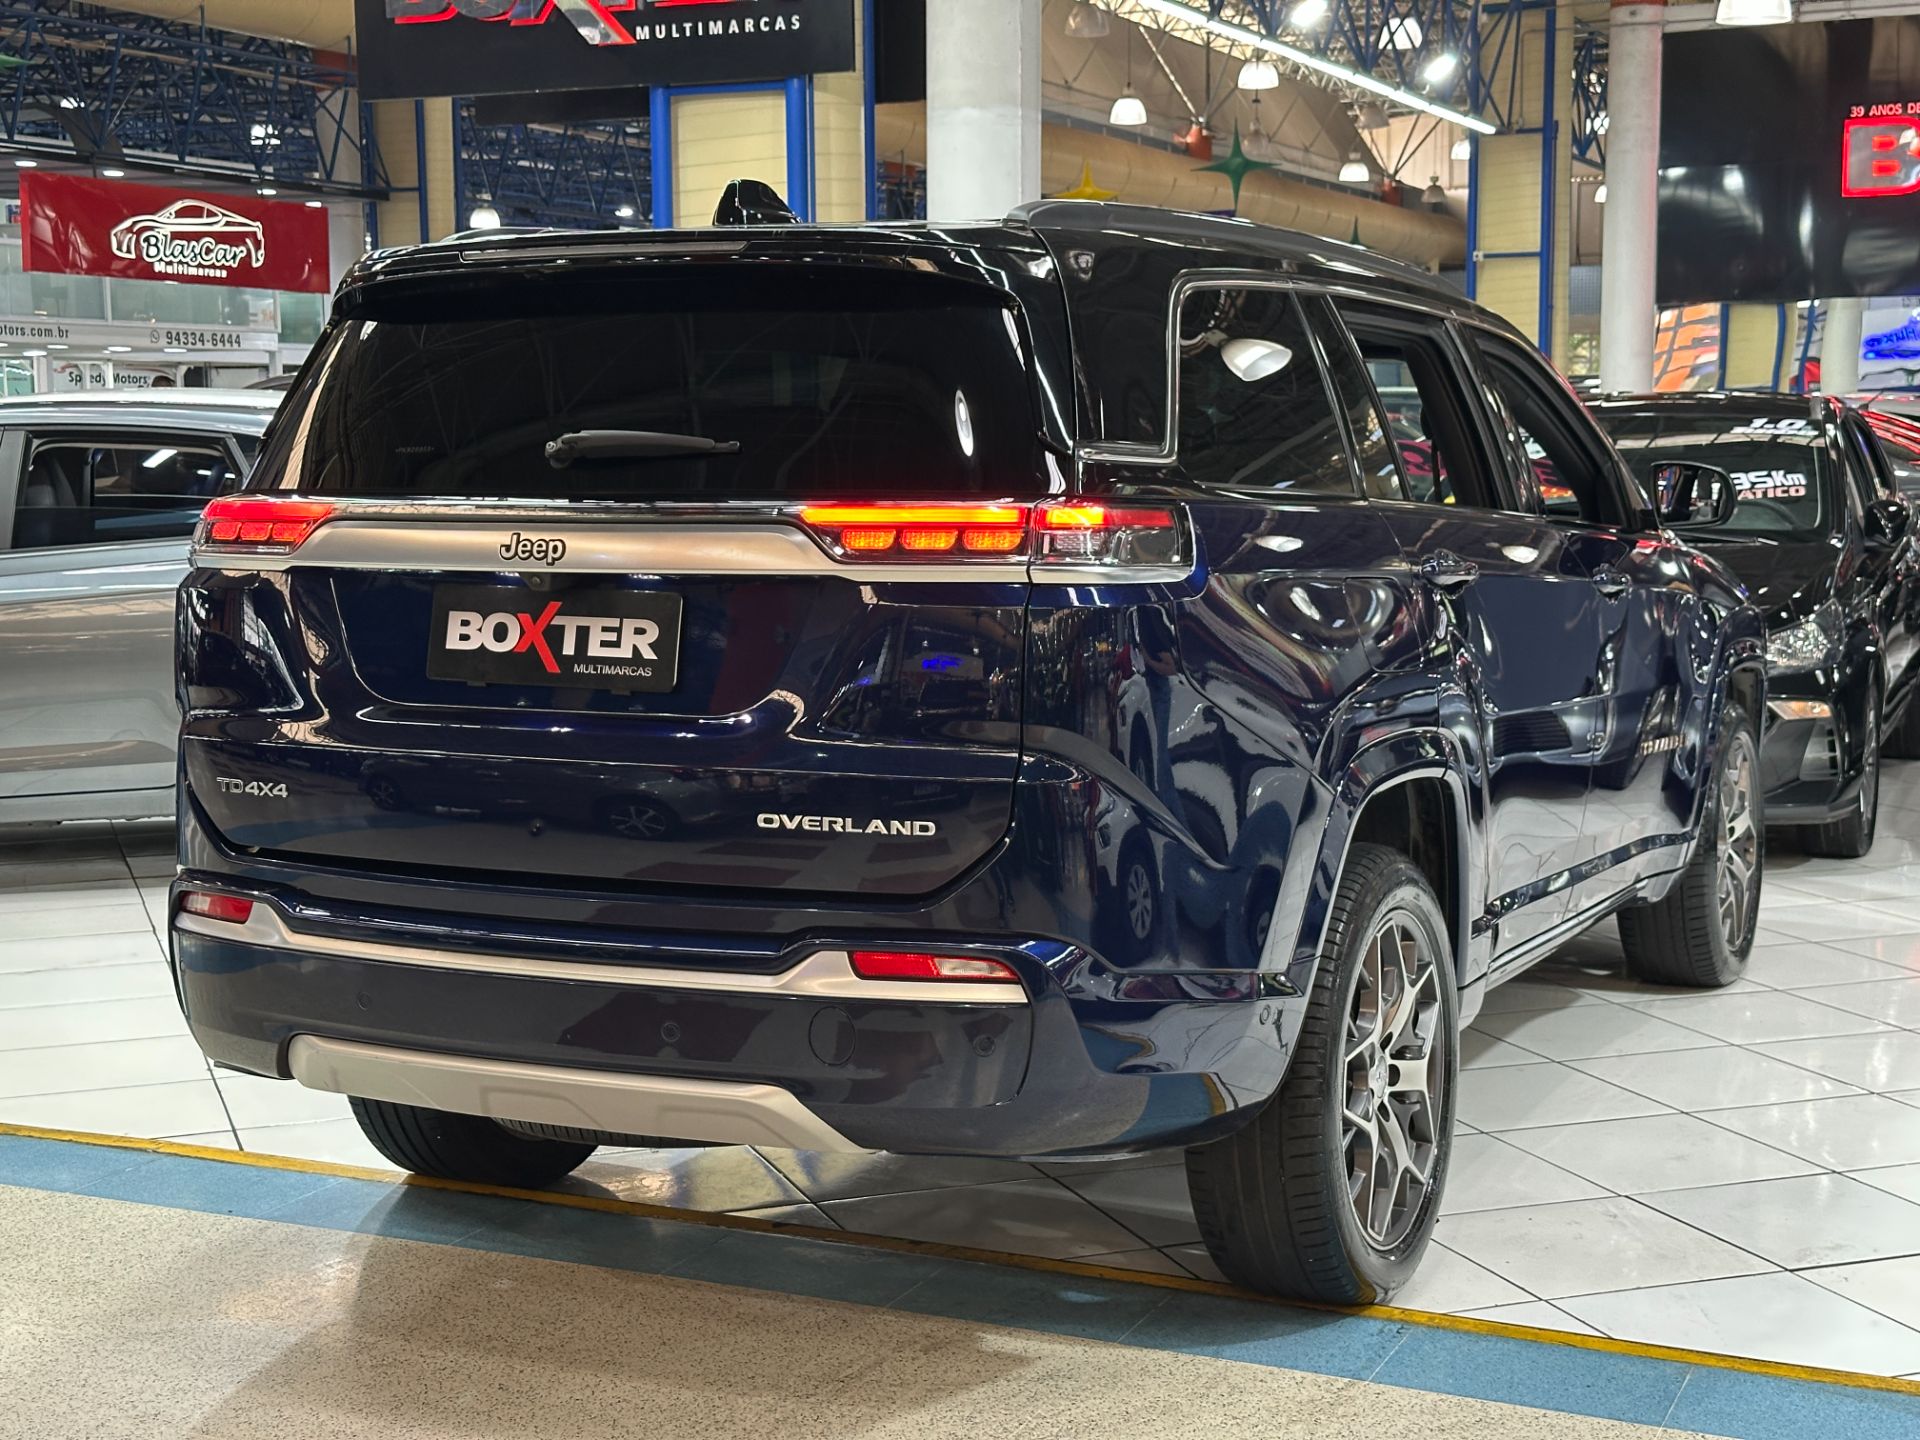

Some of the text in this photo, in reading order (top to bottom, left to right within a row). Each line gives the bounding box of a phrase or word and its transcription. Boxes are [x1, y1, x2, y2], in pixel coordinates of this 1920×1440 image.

[635, 14, 800, 41] MULTIMARCAS
[1850, 106, 1865, 117] 39
[1868, 103, 1902, 116] ANOS
[140, 230, 247, 268] BlasCar
[165, 330, 242, 348] 94334-6444
[499, 532, 567, 566] Jeep
[445, 601, 660, 674] BOXTER
[573, 663, 653, 678] MULTIMARCAS
[756, 812, 937, 837] OVERLAND
